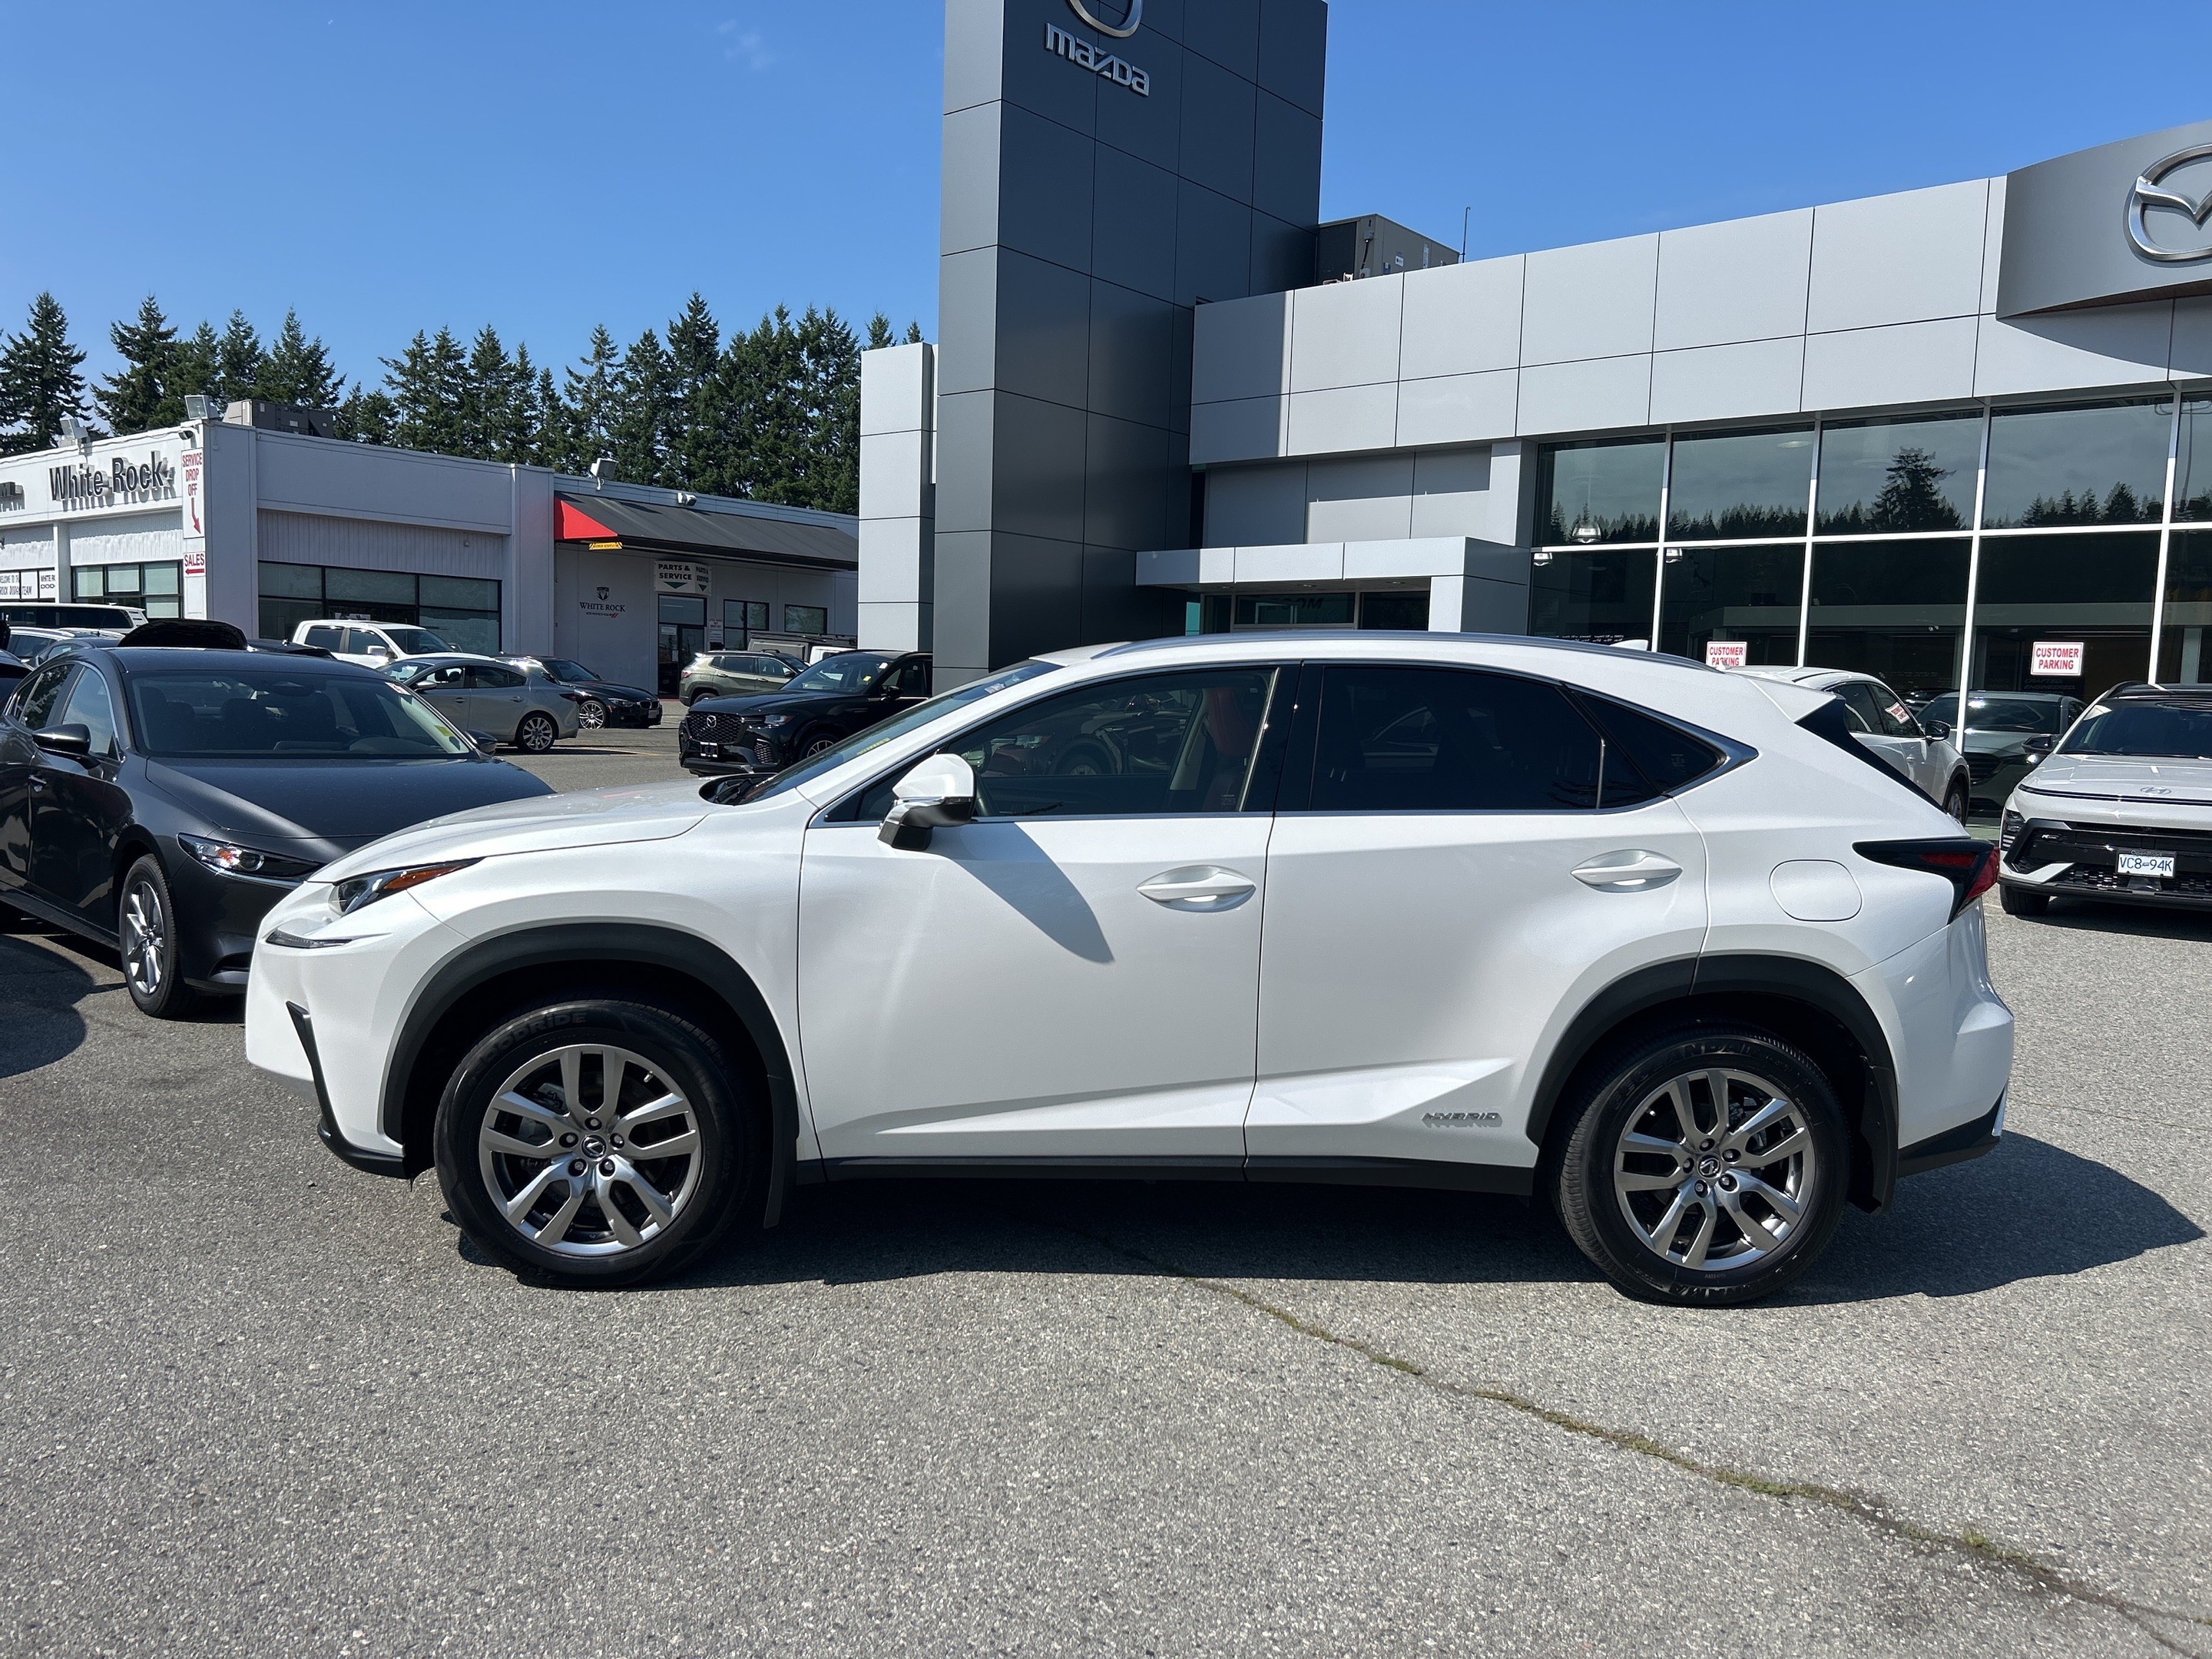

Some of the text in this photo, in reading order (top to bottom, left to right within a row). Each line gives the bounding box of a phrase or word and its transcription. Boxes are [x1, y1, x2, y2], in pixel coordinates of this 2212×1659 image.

[182, 452, 203, 467] SERVICE
[49, 463, 103, 501] White
[111, 451, 164, 493] Rock
[185, 468, 200, 482] DROP
[187, 483, 198, 497] OFF
[184, 553, 205, 567] SALES
[659, 572, 693, 581] SERVICE
[579, 601, 626, 612] WHITE ROCK
[1709, 646, 1743, 656] CUSTOMER
[2035, 647, 2079, 657] CUSTOMER
[2038, 659, 2074, 670] PARKING
[1421, 1112, 1502, 1128] HYBRID
